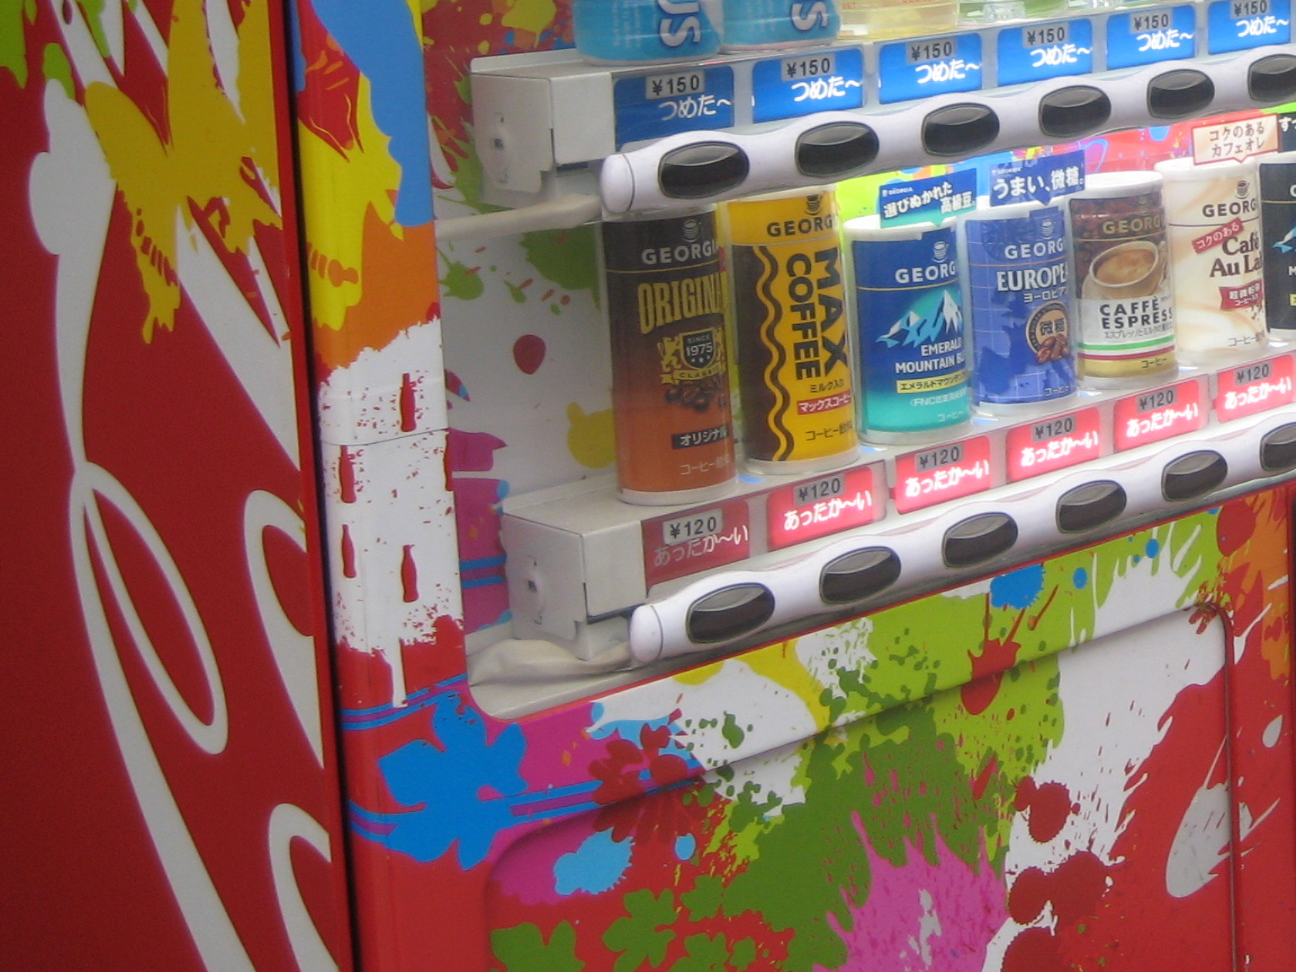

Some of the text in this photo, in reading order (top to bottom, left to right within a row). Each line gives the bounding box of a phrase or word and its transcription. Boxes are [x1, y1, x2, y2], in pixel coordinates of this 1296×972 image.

[1233, 0, 1267, 16] ¥150
[1133, 14, 1169, 31] ¥150
[1027, 26, 1065, 45] ¥150
[911, 42, 953, 61] ¥150
[786, 59, 831, 78] ¥150
[651, 78, 700, 96] ¥150
[1209, 122, 1266, 142] コクのある
[1211, 139, 1266, 158] カフェオレ
[1210, 259, 1240, 278] Au
[786, 252, 822, 380] COFFEE
[814, 247, 847, 377] MAX
[686, 343, 713, 356] 1975
[895, 355, 955, 374] MOUNTAIN
[1235, 365, 1269, 384] ¥120
[1139, 389, 1174, 410] ¥120
[1034, 417, 1073, 439] ¥120
[918, 445, 960, 469] ¥120
[798, 477, 841, 501] ¥120
[670, 516, 718, 538] ¥120
